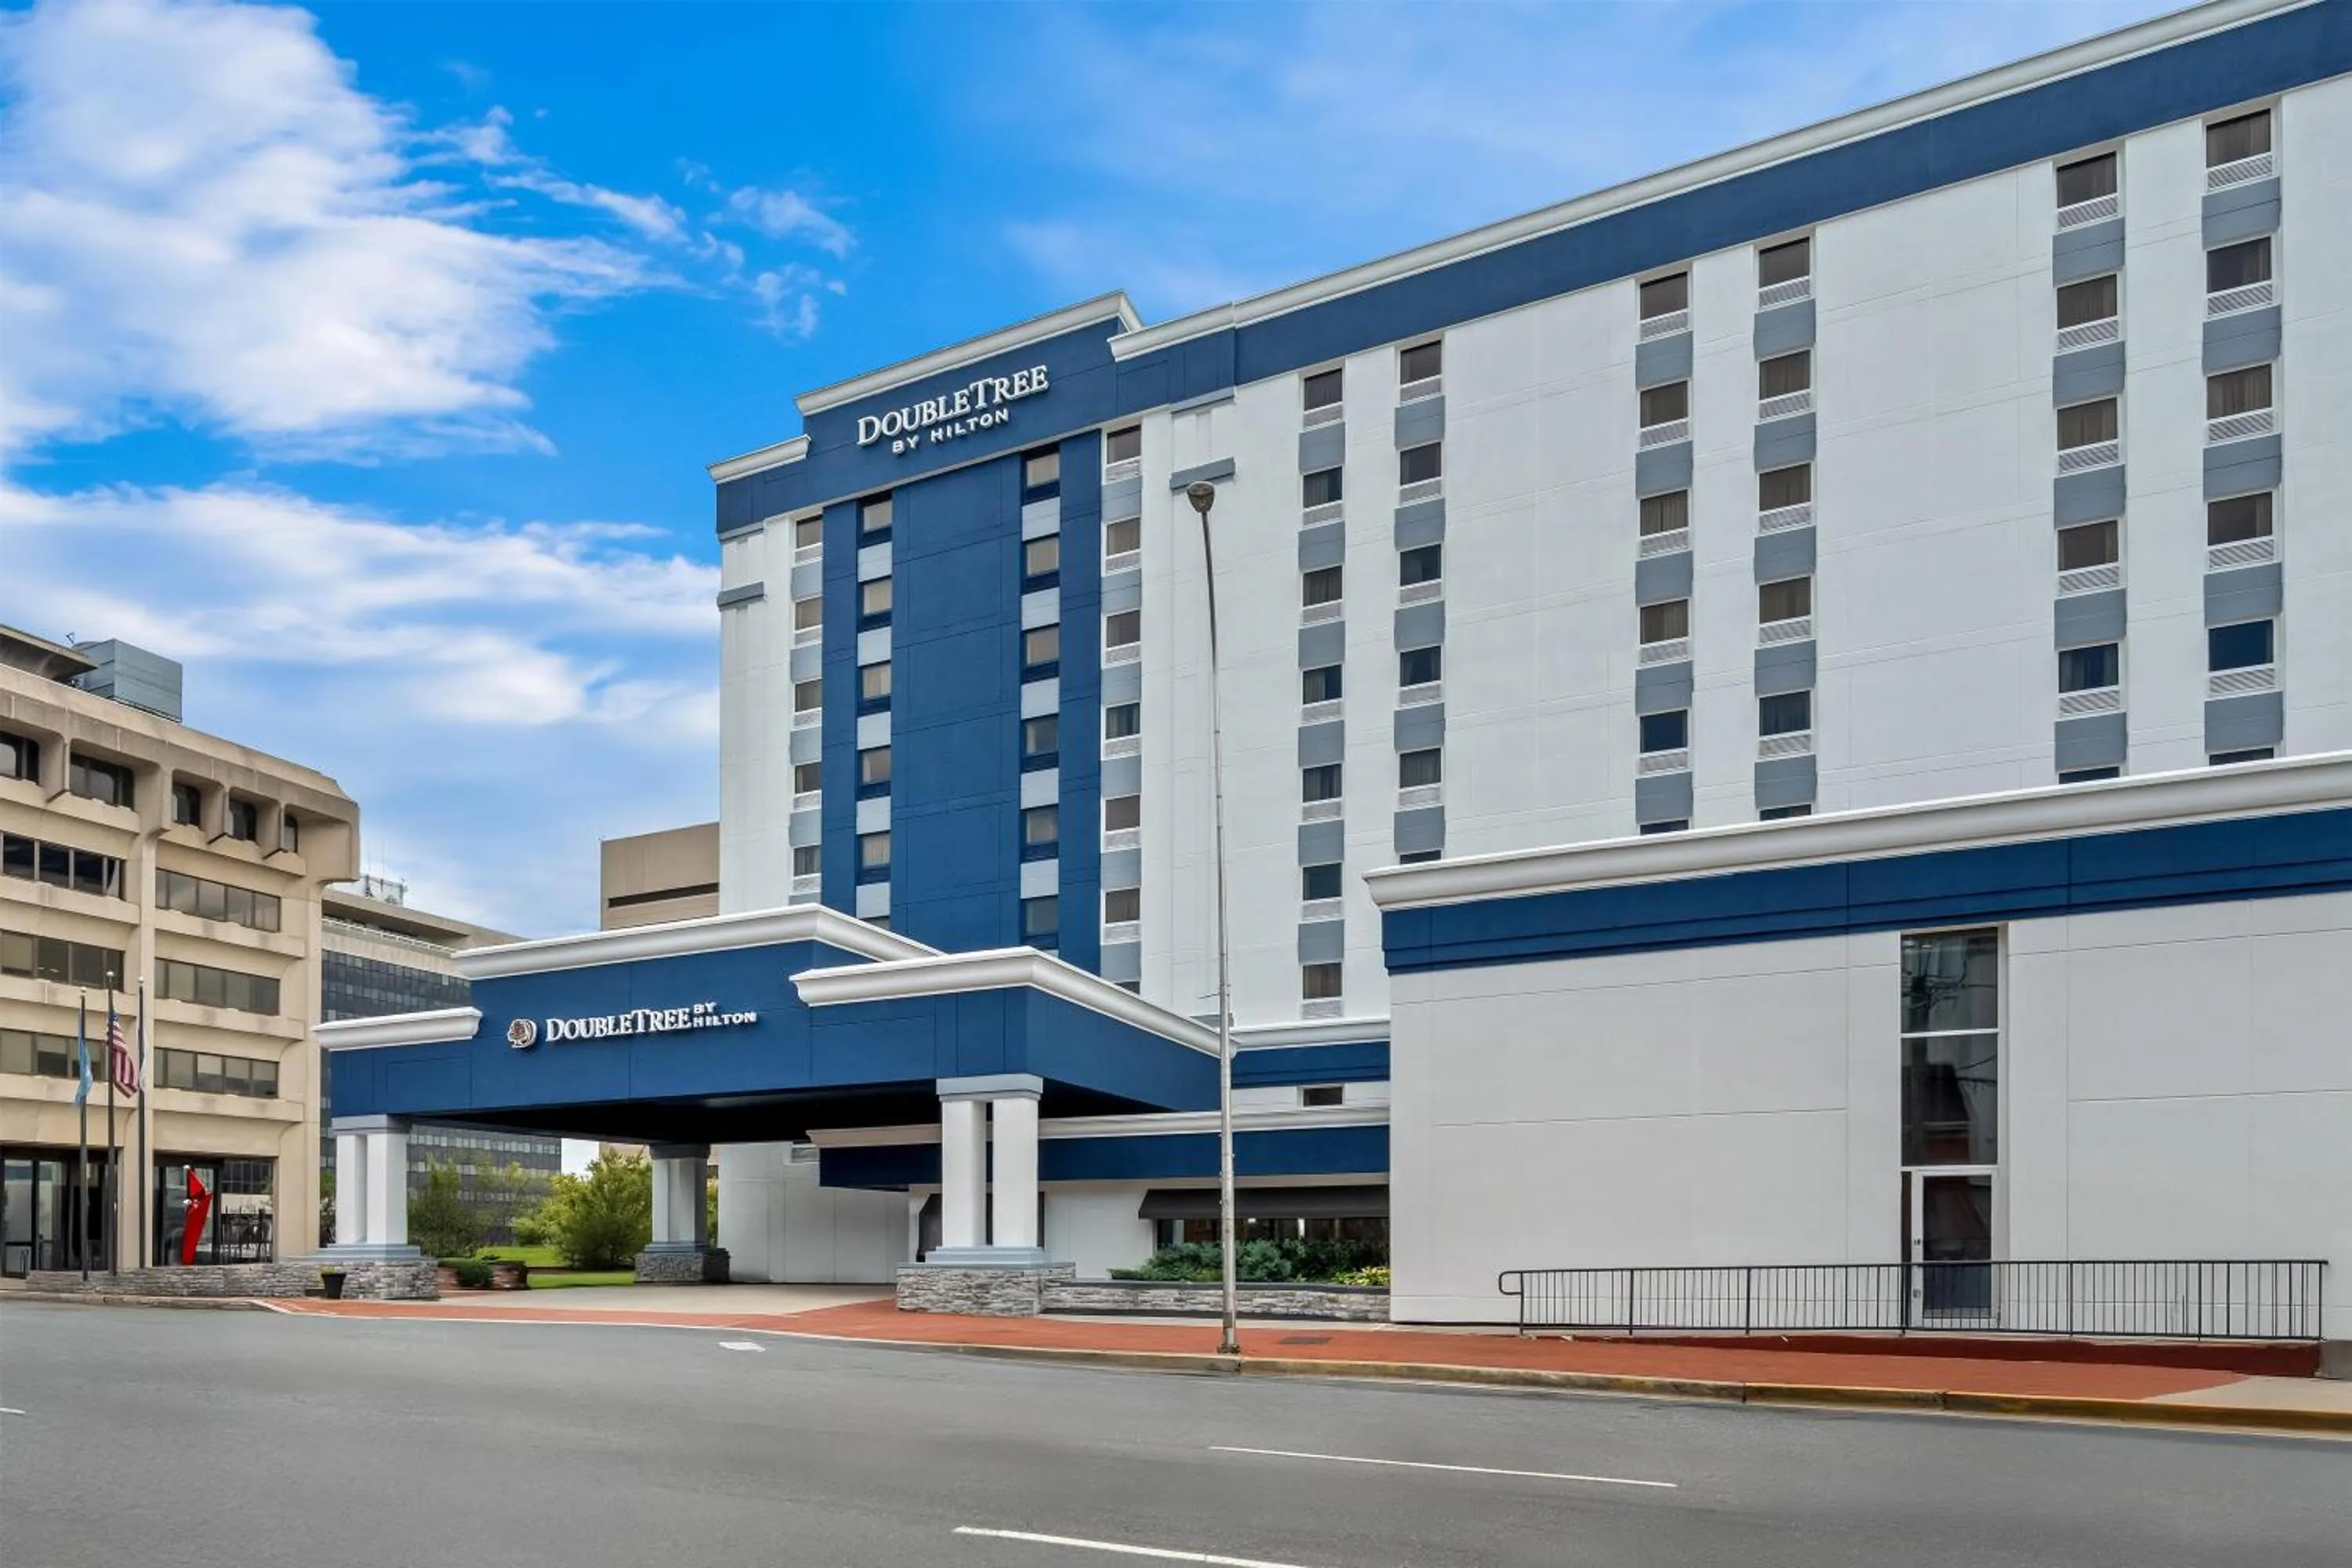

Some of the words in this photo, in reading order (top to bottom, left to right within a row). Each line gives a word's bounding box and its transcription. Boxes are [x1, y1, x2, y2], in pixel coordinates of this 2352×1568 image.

[857, 365, 1048, 445] DOUBLETREE
[891, 435, 920, 454] BY
[931, 408, 1009, 443] HILTON
[693, 1012, 756, 1027] HILTON
[694, 1002, 717, 1013] BY
[546, 1008, 691, 1042] DOUBLETREE
